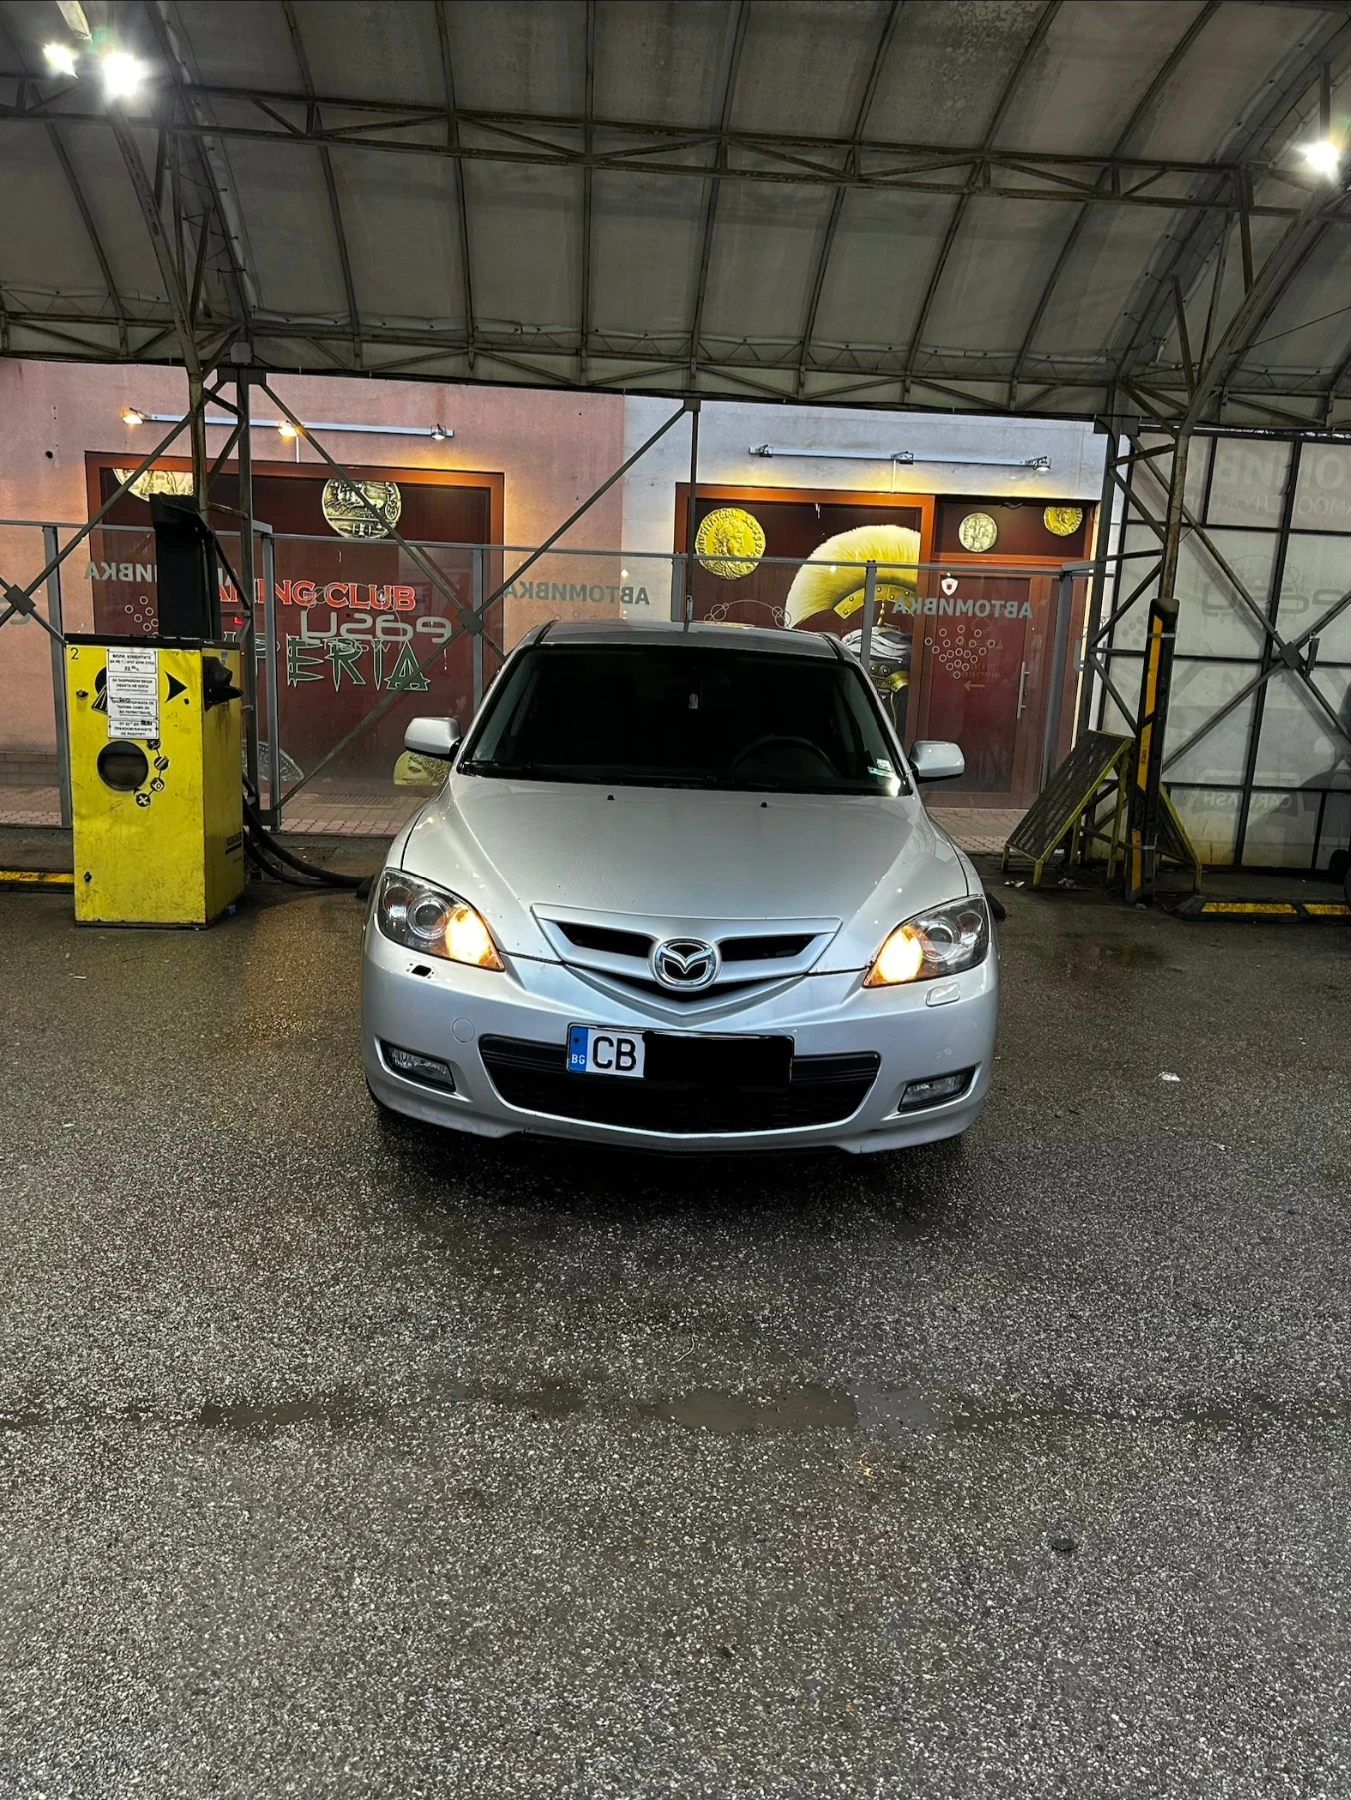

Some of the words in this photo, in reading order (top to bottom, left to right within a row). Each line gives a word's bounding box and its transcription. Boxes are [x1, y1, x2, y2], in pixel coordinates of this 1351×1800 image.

[324, 581, 416, 611] CLUB
[70, 647, 79, 660] 2
[571, 1053, 586, 1064] BG
[592, 1036, 637, 1071] CB
